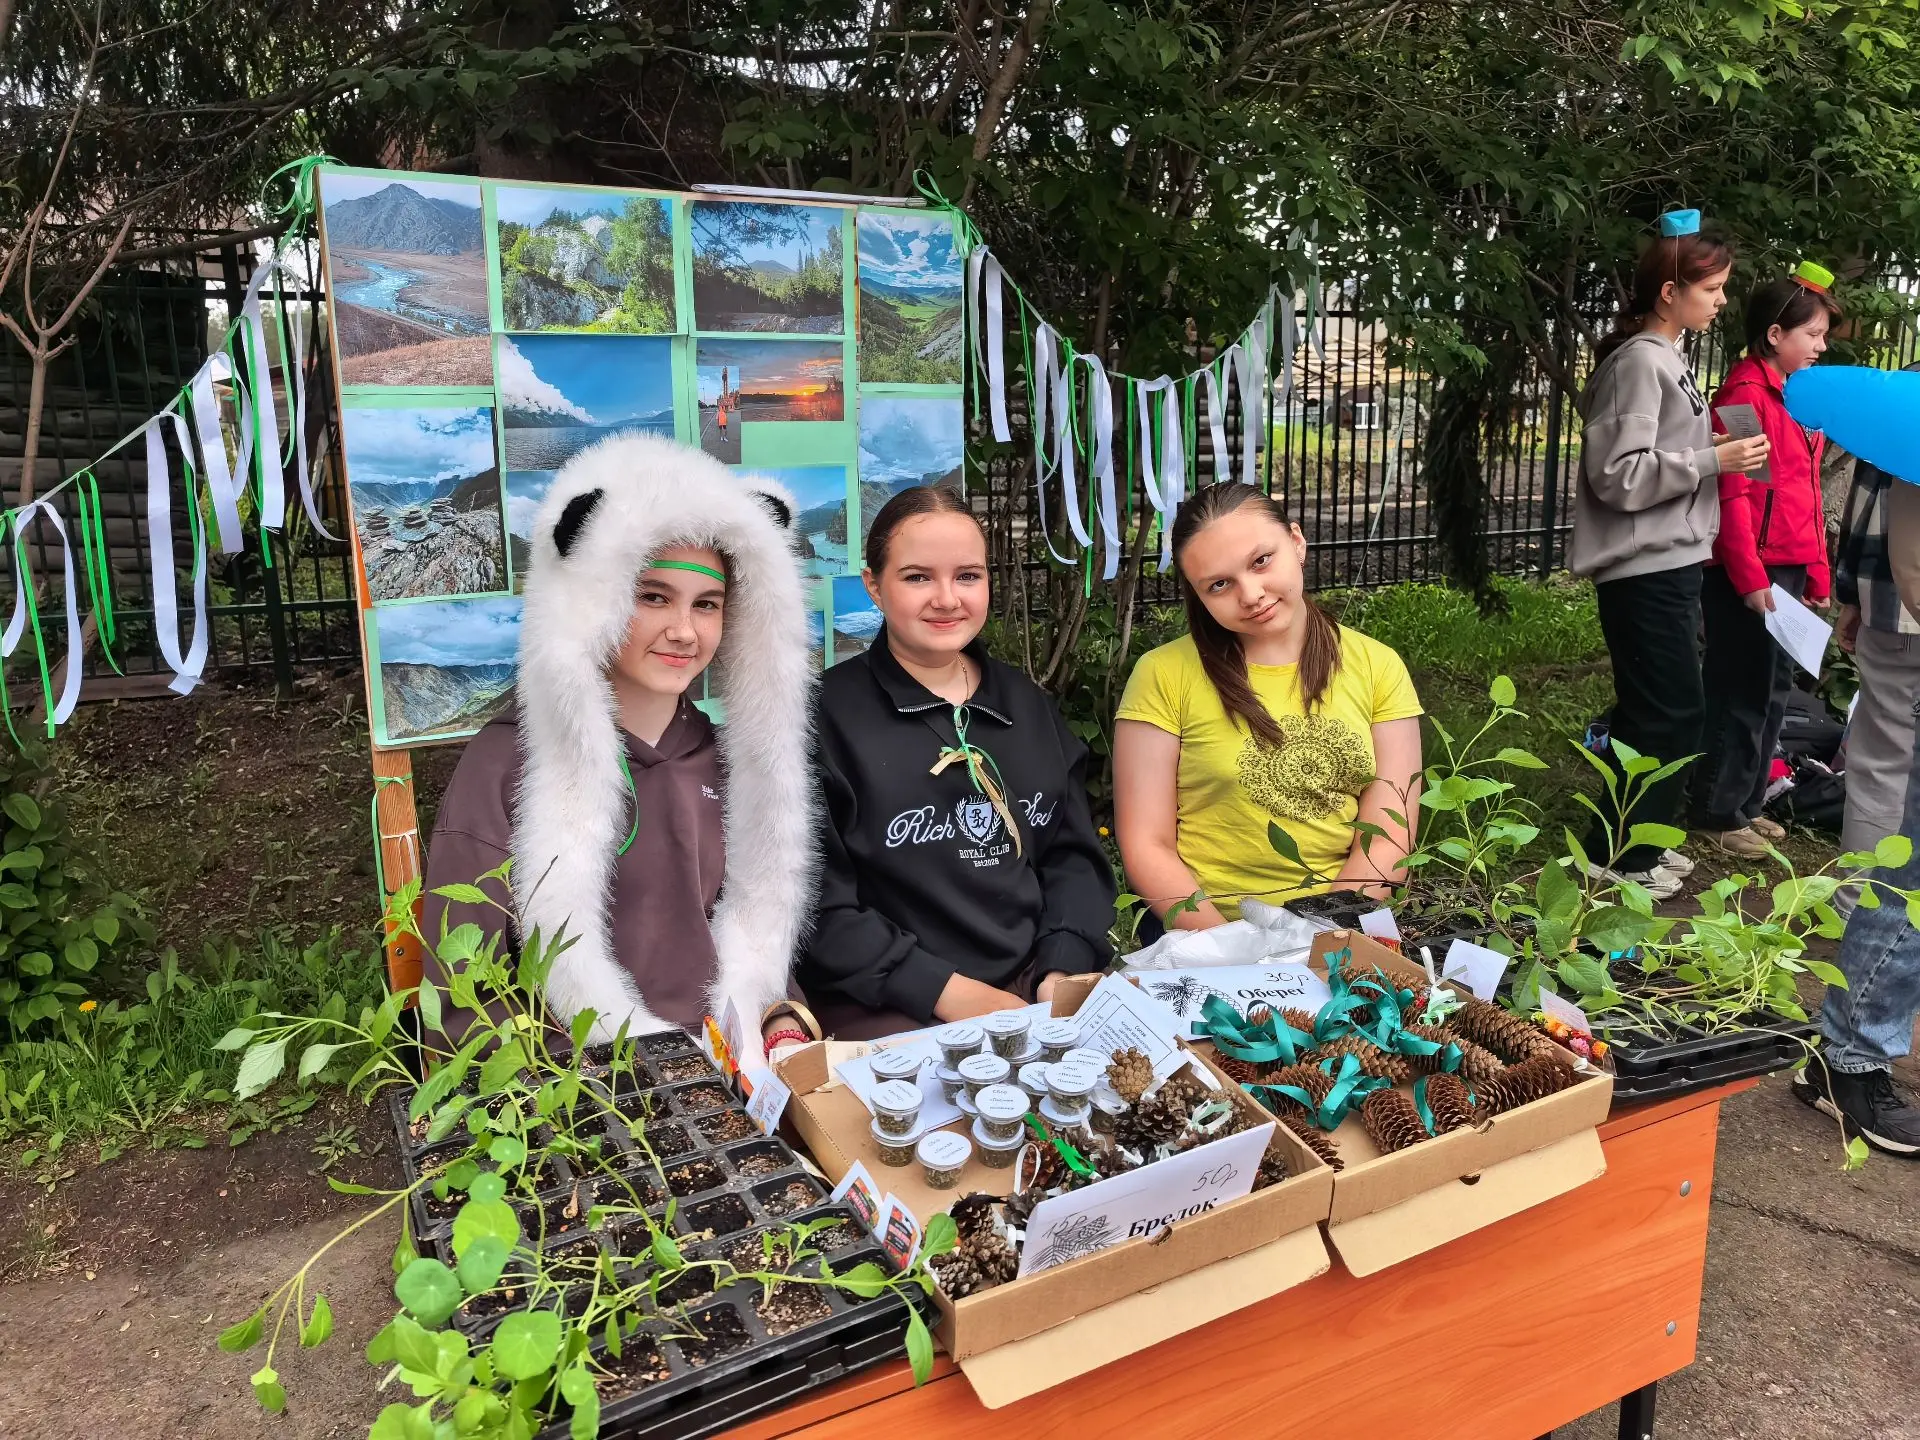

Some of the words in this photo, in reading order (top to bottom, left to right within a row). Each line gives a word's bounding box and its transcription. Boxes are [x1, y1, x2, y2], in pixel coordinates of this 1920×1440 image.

[885, 805, 956, 848] Rich
[958, 847, 986, 859] ROYAL
[989, 843, 1010, 855] CLUB
[1237, 986, 1305, 999] Оберег
[1128, 1196, 1218, 1238] Брелок
